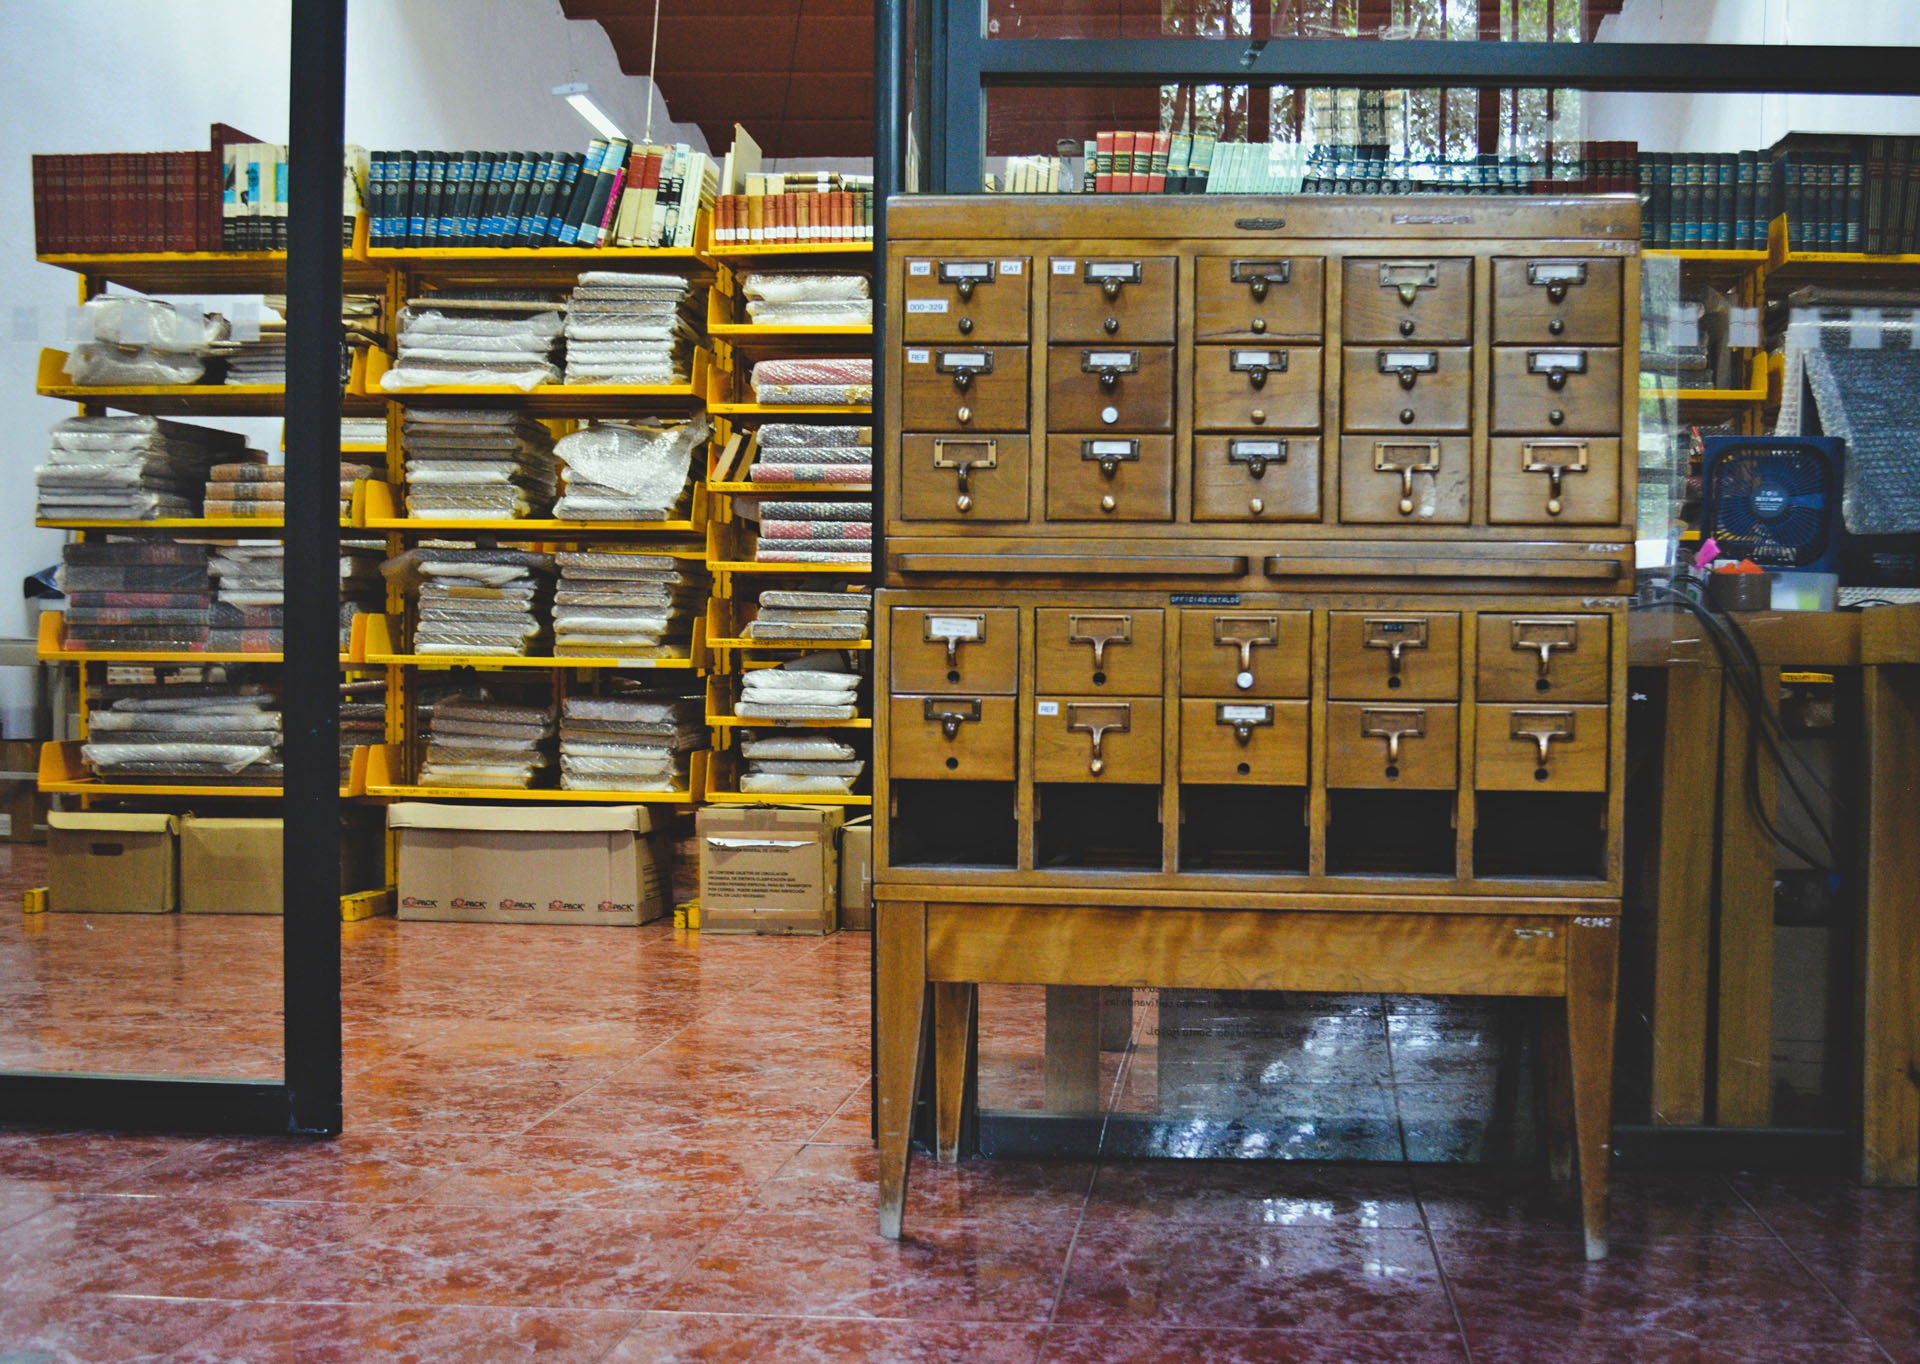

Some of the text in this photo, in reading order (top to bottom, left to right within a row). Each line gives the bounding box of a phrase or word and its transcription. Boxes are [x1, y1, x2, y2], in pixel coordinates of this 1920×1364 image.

[913, 265, 928, 273] REF
[1002, 264, 1019, 272] CAT
[1057, 264, 1073, 272] REF
[911, 353, 926, 361] REF
